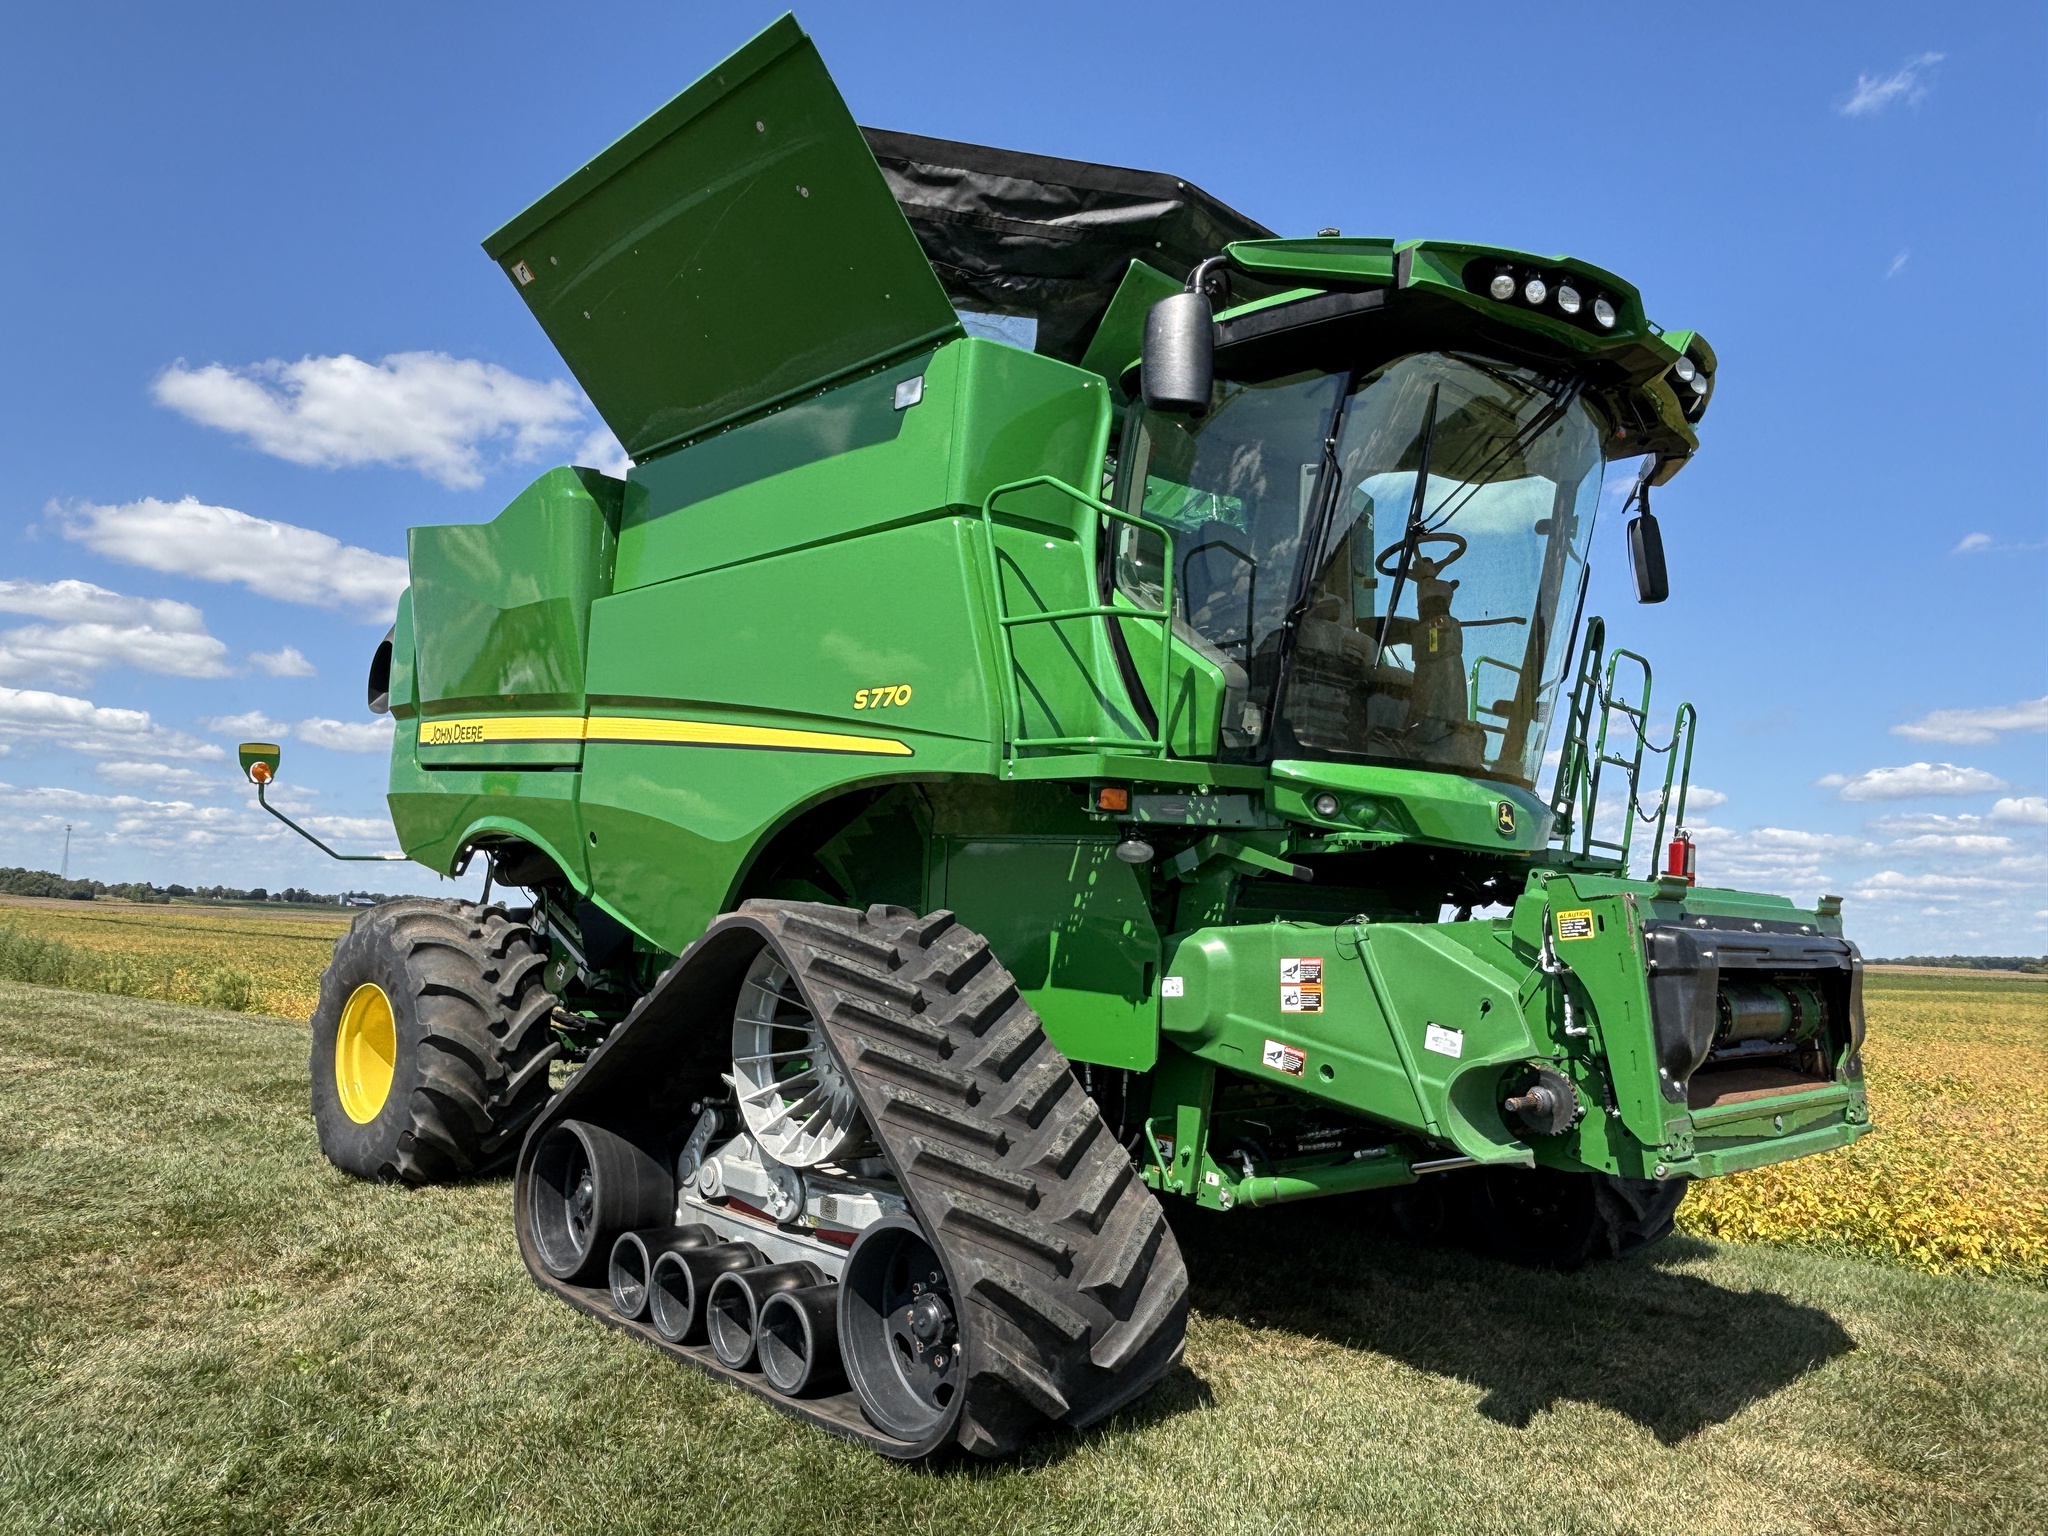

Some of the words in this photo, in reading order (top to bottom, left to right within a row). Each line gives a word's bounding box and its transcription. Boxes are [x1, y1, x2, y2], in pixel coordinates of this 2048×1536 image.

[853, 684, 912, 710] S770
[430, 725, 453, 743] JOHN
[453, 724, 484, 741] DEERE
